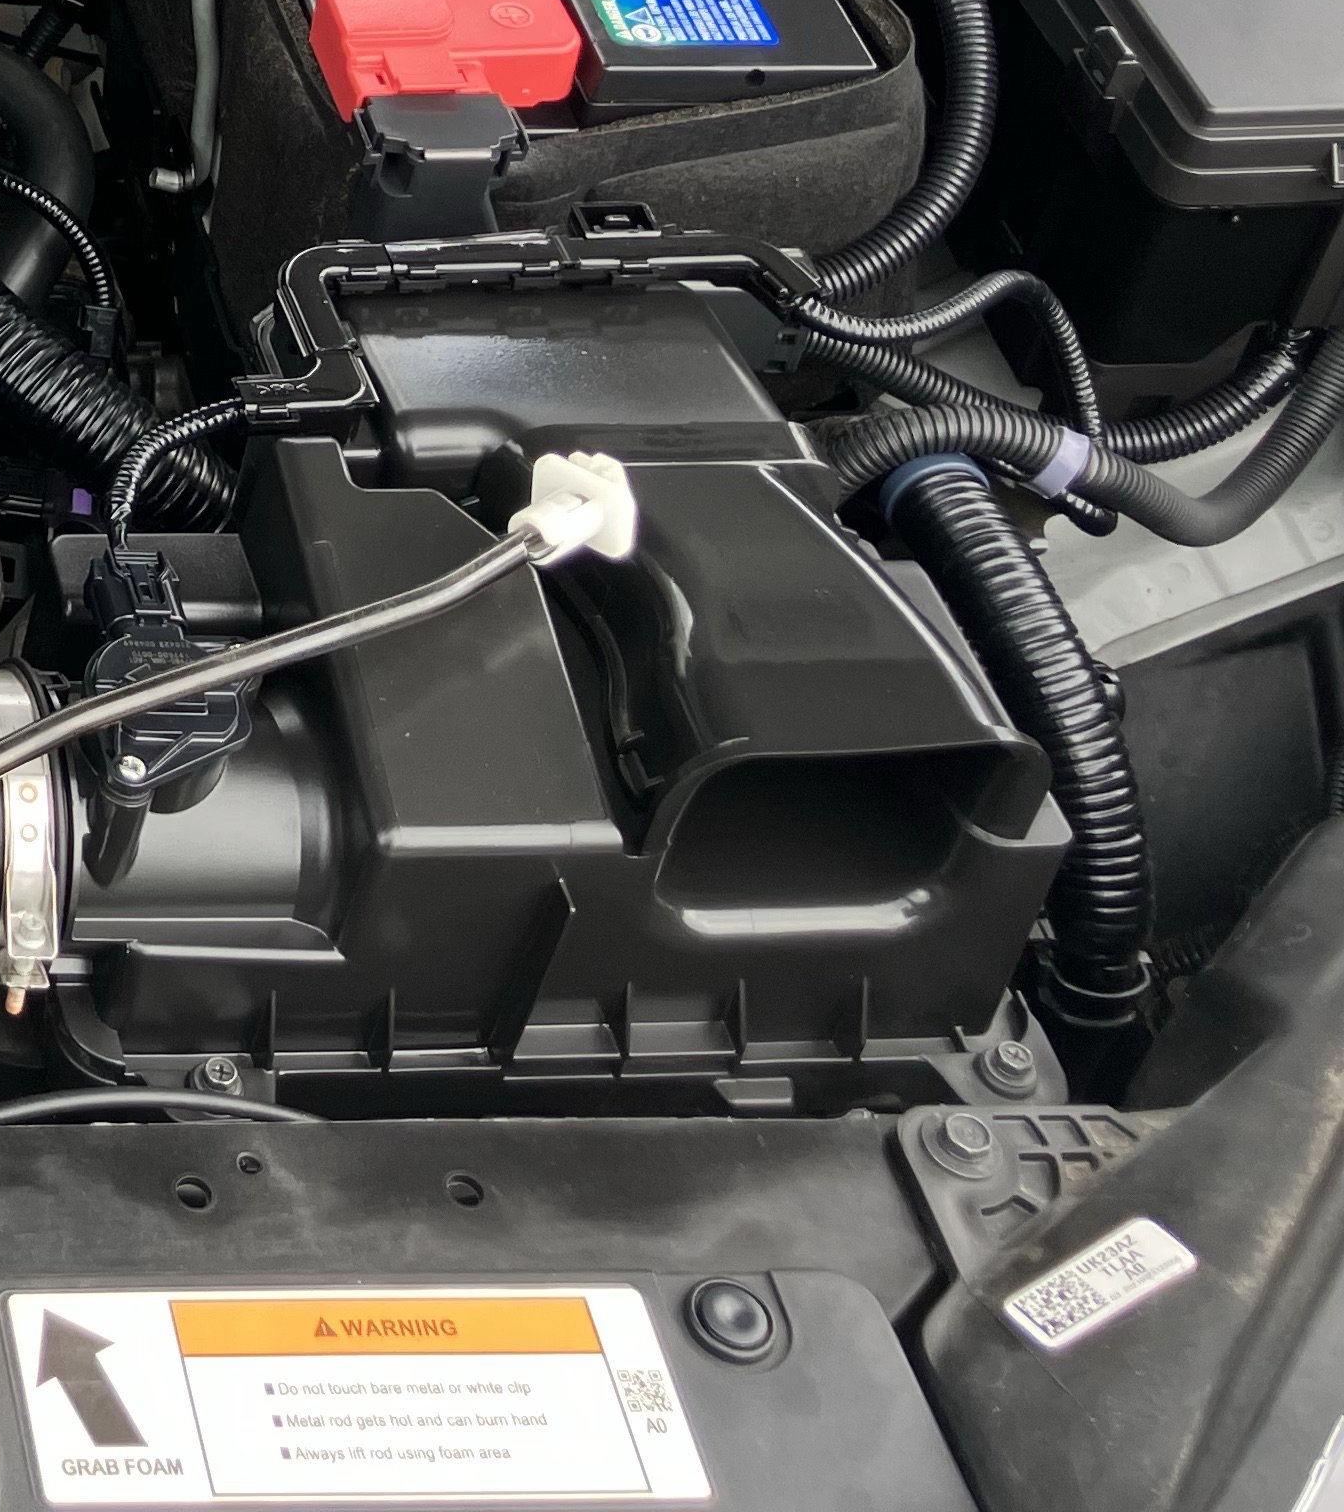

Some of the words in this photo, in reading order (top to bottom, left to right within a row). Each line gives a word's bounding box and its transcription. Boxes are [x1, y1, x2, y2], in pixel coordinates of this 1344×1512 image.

[1100, 1249, 1145, 1278] TLAA
[340, 1318, 458, 1337] WARNING
[278, 1382, 299, 1396] Do
[302, 1382, 325, 1396] not
[327, 1381, 366, 1396] touch
[370, 1381, 402, 1395] bare
[406, 1381, 445, 1395] metal
[448, 1384, 463, 1395] or
[466, 1380, 503, 1395] white
[507, 1380, 532, 1398] clip
[286, 1414, 325, 1428] Metal
[329, 1413, 354, 1428] rod
[356, 1414, 386, 1431] gets
[390, 1414, 413, 1427] hot
[417, 1414, 443, 1427] and
[447, 1416, 473, 1427] can
[475, 1413, 509, 1427] burn
[511, 1413, 548, 1426] hand
[295, 1446, 345, 1463] Always
[347, 1445, 367, 1460] lift
[370, 1446, 393, 1460] rod
[398, 1446, 436, 1463] using
[438, 1445, 475, 1459] foam
[479, 1448, 511, 1460] area
[62, 1458, 120, 1476] GRAB
[124, 1457, 184, 1475] FOAM
